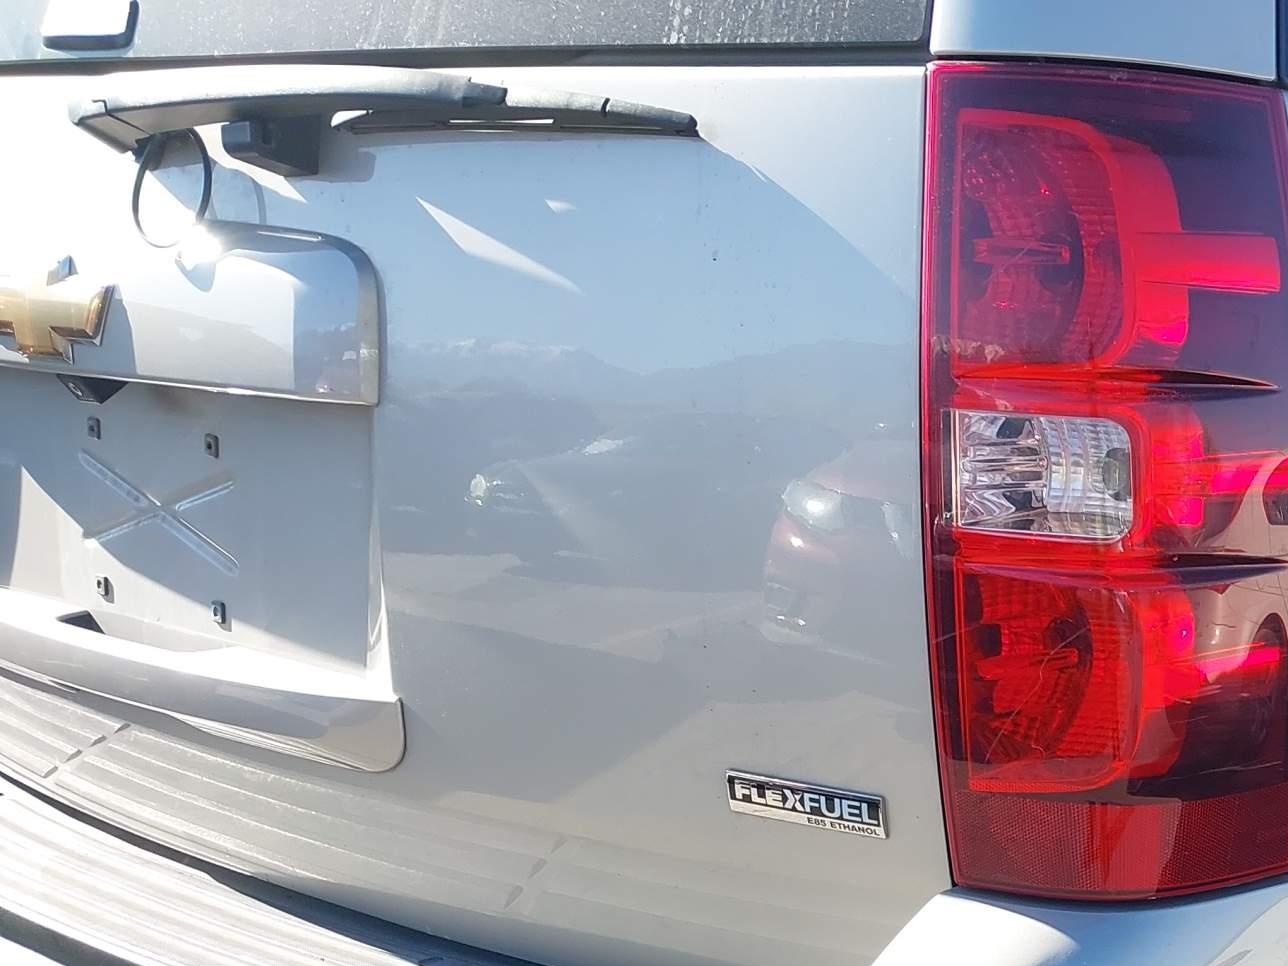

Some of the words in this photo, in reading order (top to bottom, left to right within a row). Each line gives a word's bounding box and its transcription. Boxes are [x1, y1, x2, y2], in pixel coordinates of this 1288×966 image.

[734, 779, 879, 825] FLEXFUEL
[807, 816, 827, 827] E85
[830, 821, 881, 837] ETHANOL
